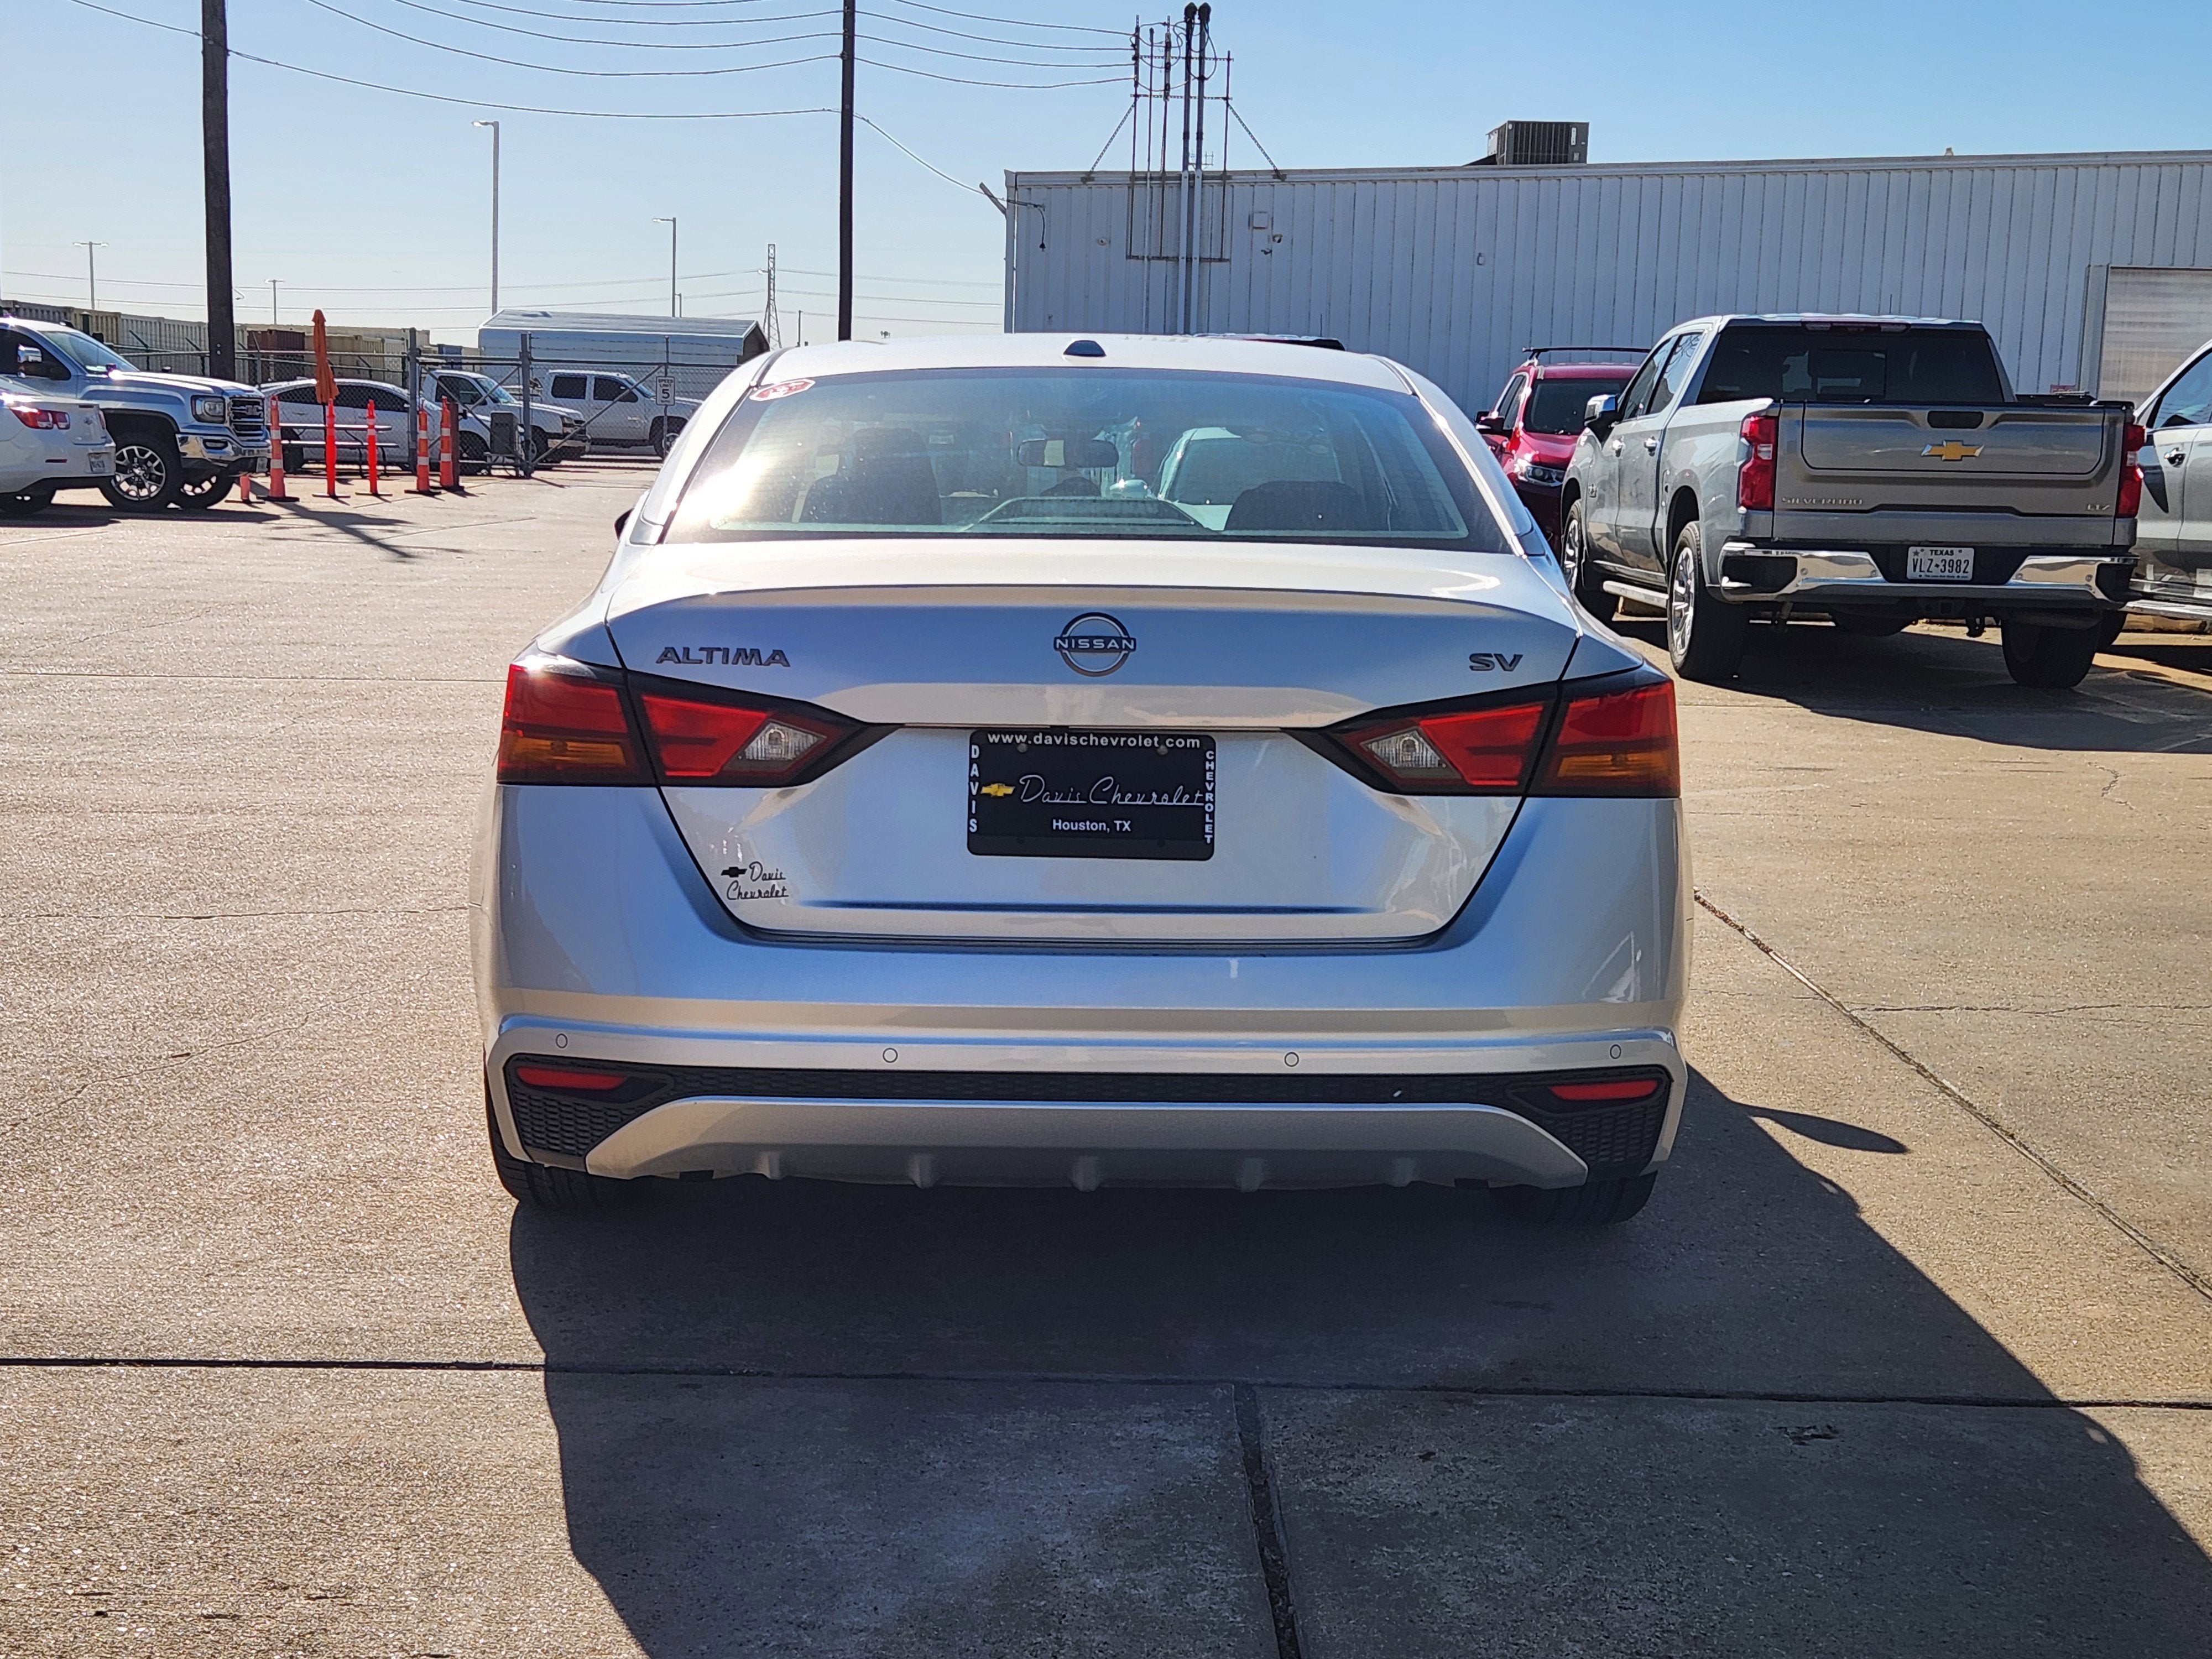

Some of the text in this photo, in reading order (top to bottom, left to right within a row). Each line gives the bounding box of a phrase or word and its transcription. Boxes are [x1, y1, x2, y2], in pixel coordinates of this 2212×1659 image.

[661, 388, 670, 399] 5
[1056, 639, 1134, 649] NISSAN
[656, 647, 791, 667] ALTIMA
[1469, 653, 1524, 672] SV
[988, 732, 1200, 748] www.davischevroletcom
[1019, 774, 1204, 806] Davis Chevrolet
[1052, 819, 1131, 833] Houston, TX
[749, 861, 786, 881] Davis
[726, 880, 789, 900] Chevrolet
